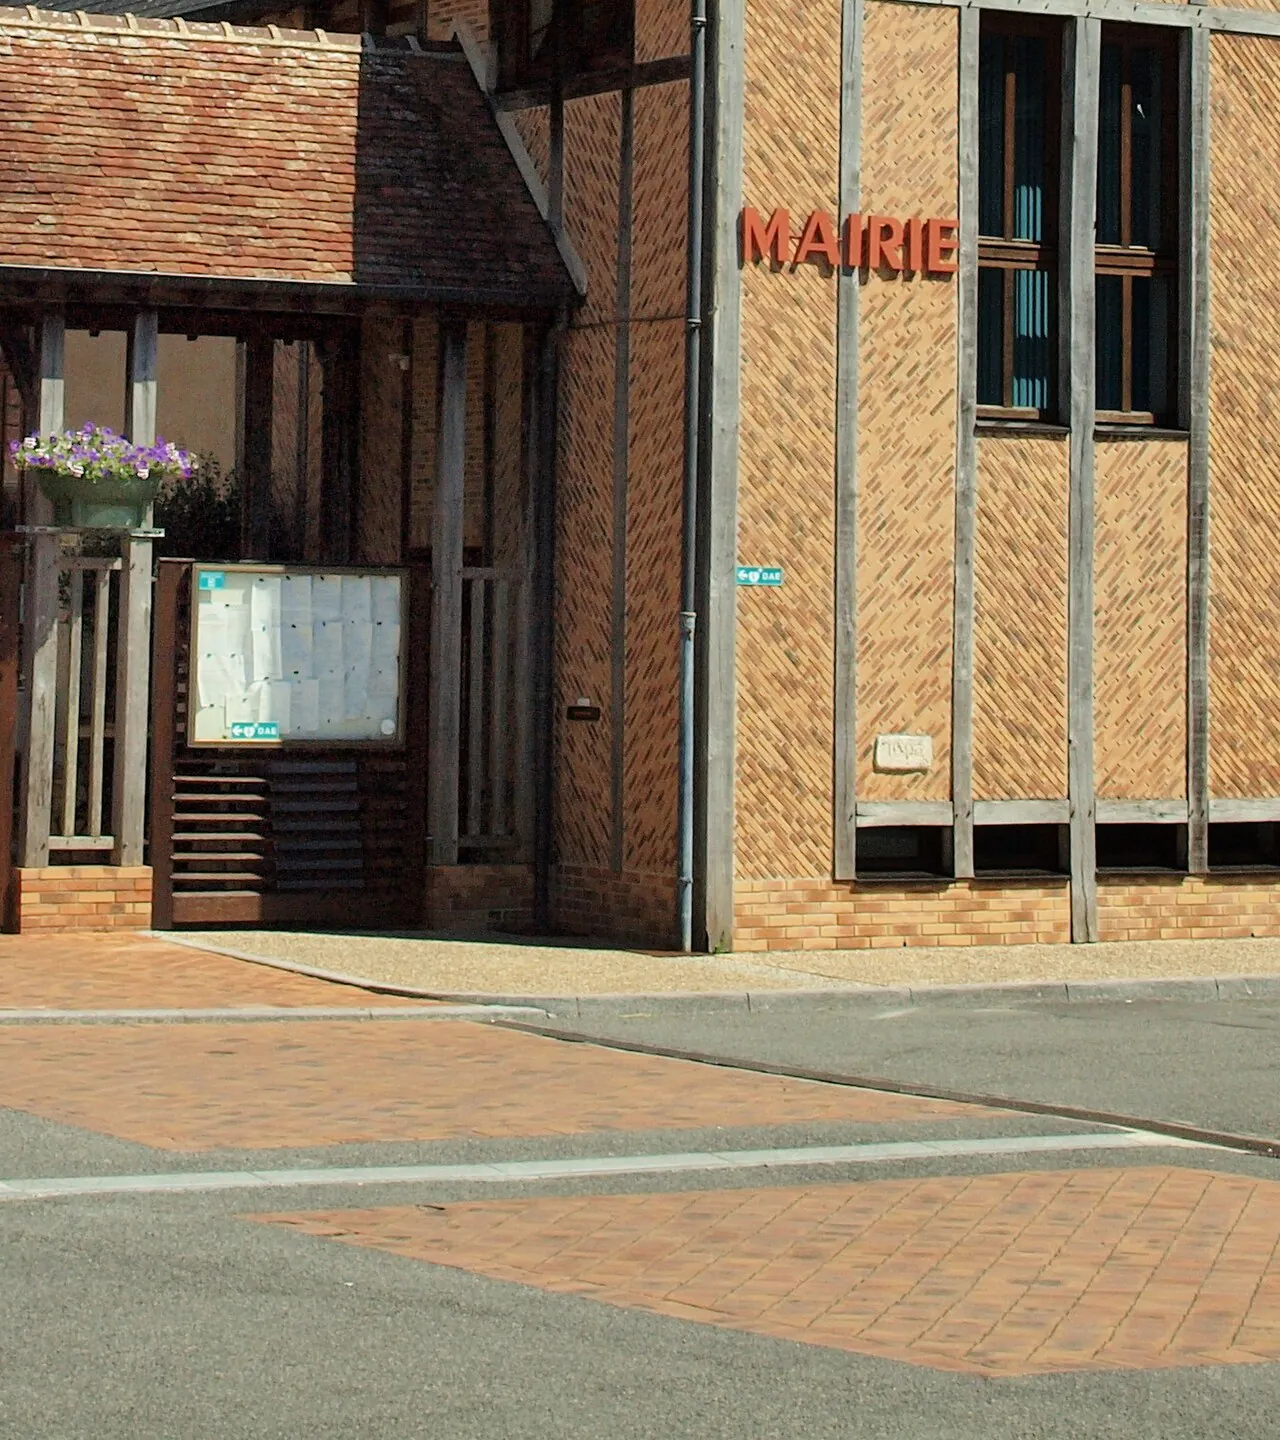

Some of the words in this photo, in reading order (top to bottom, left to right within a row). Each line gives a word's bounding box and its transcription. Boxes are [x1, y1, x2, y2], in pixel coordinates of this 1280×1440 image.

[743, 207, 959, 273] MAIRIE
[761, 571, 780, 581] DAE
[257, 726, 277, 736] DAE
